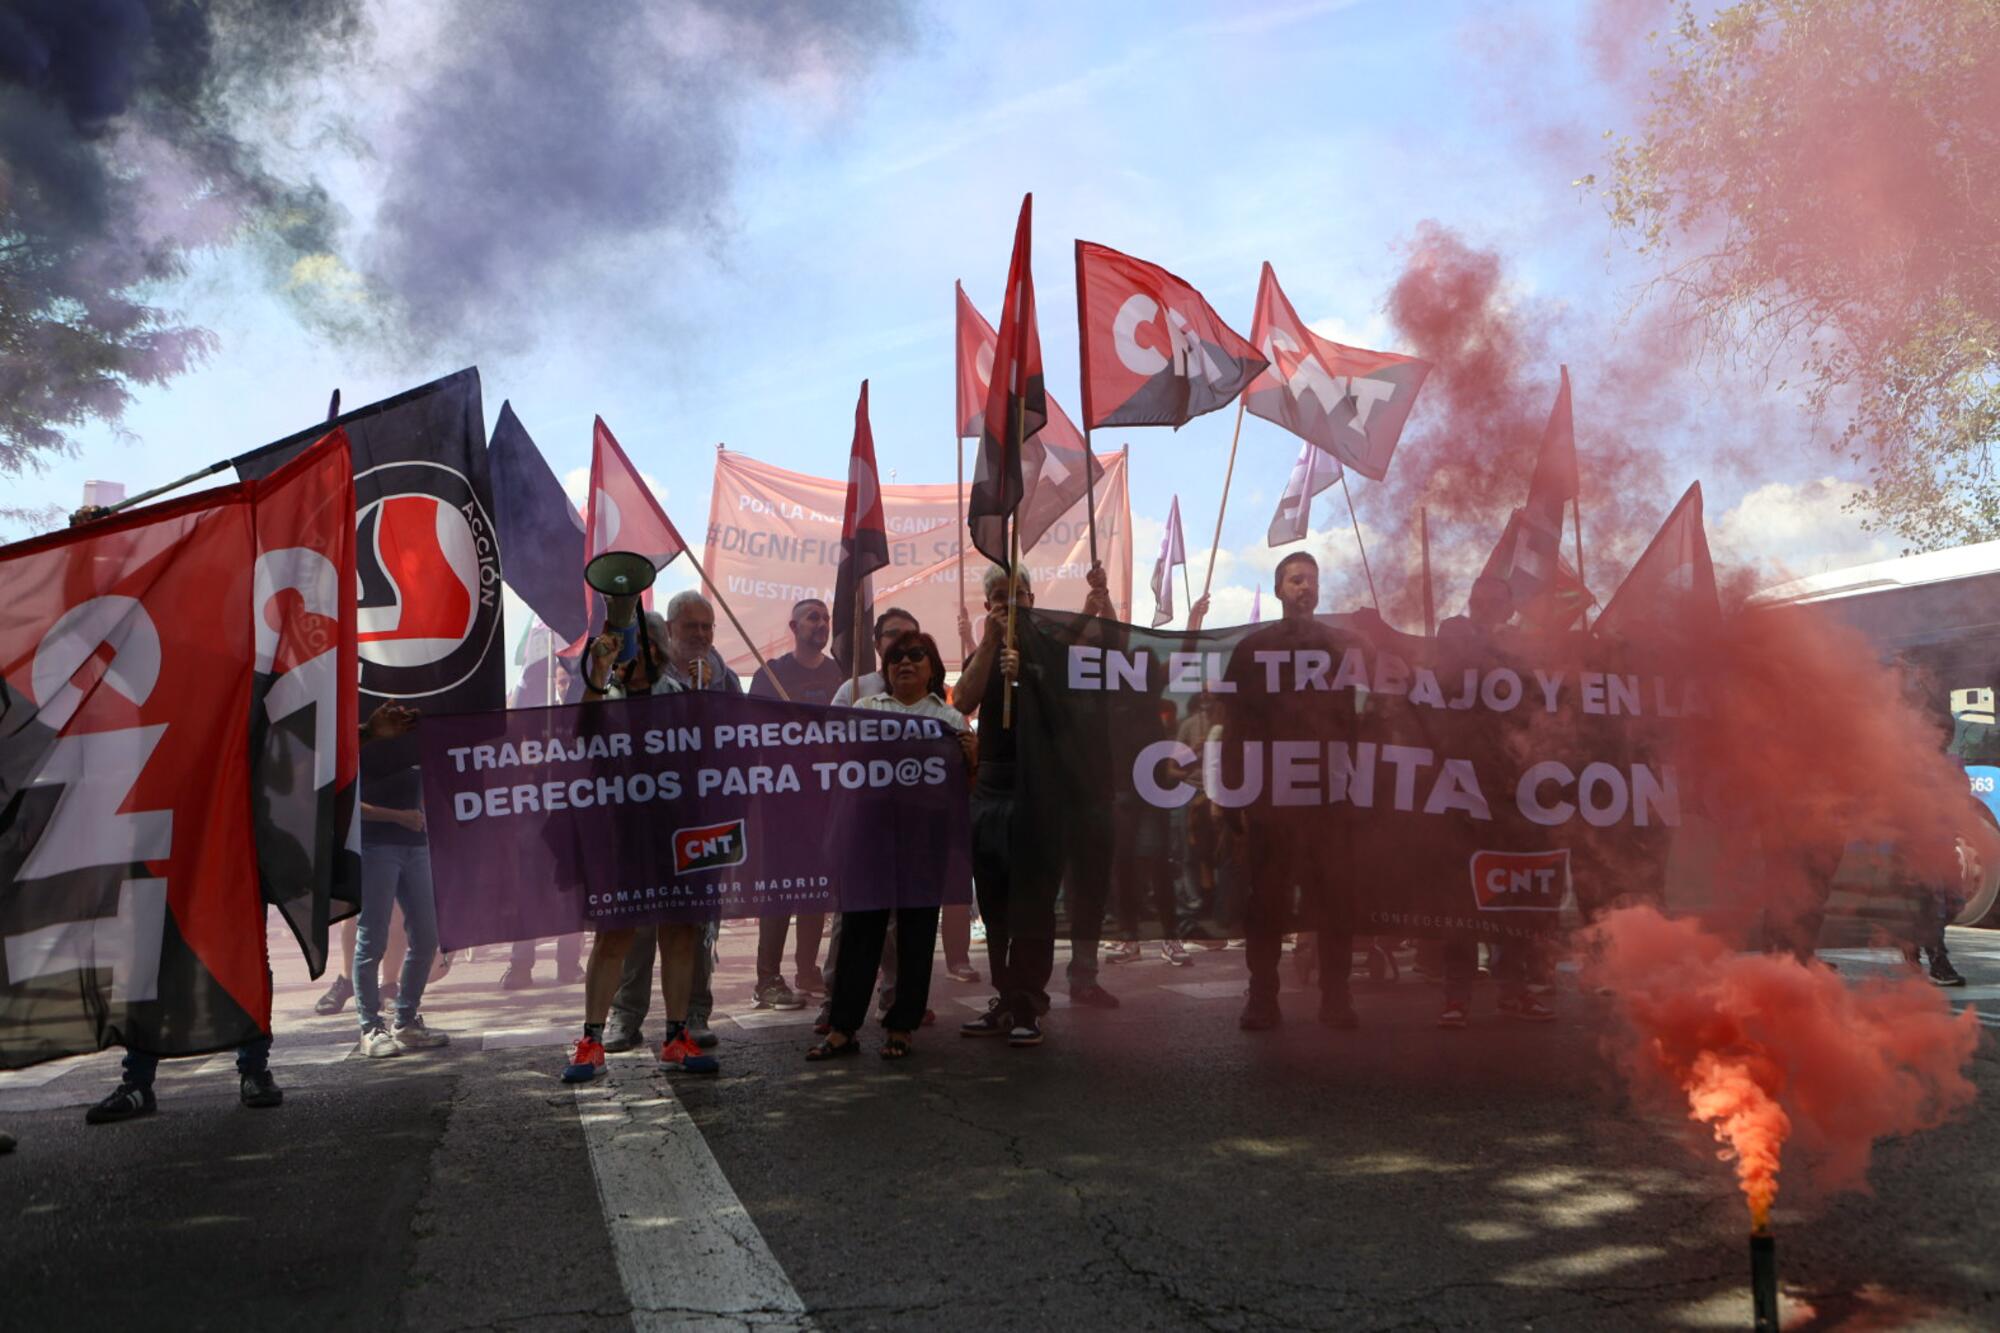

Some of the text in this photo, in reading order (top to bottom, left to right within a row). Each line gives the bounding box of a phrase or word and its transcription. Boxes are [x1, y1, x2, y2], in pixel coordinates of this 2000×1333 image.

[739, 495, 775, 516] POR
[781, 502, 804, 520] LA
[461, 501, 500, 608] ACCIÓN
[893, 543, 923, 567] EL
[728, 575, 818, 602] VUESTRO
[1067, 645, 1148, 692] EN
[1169, 652, 1238, 694] EL
[1254, 648, 1523, 713] TRABAJO
[1533, 669, 1566, 713] Y
[1580, 672, 1641, 716] EN
[448, 719, 943, 772] TRABAJAR SIN PRECARIEDAD
[454, 757, 947, 822] DERECHOS PARA TOD@S
[1132, 741, 1682, 827] CUENTA CON
[685, 835, 733, 860] CNT
[588, 876, 829, 905] COMARCAL SUR MADRID
[1486, 868, 1556, 894] CNT
